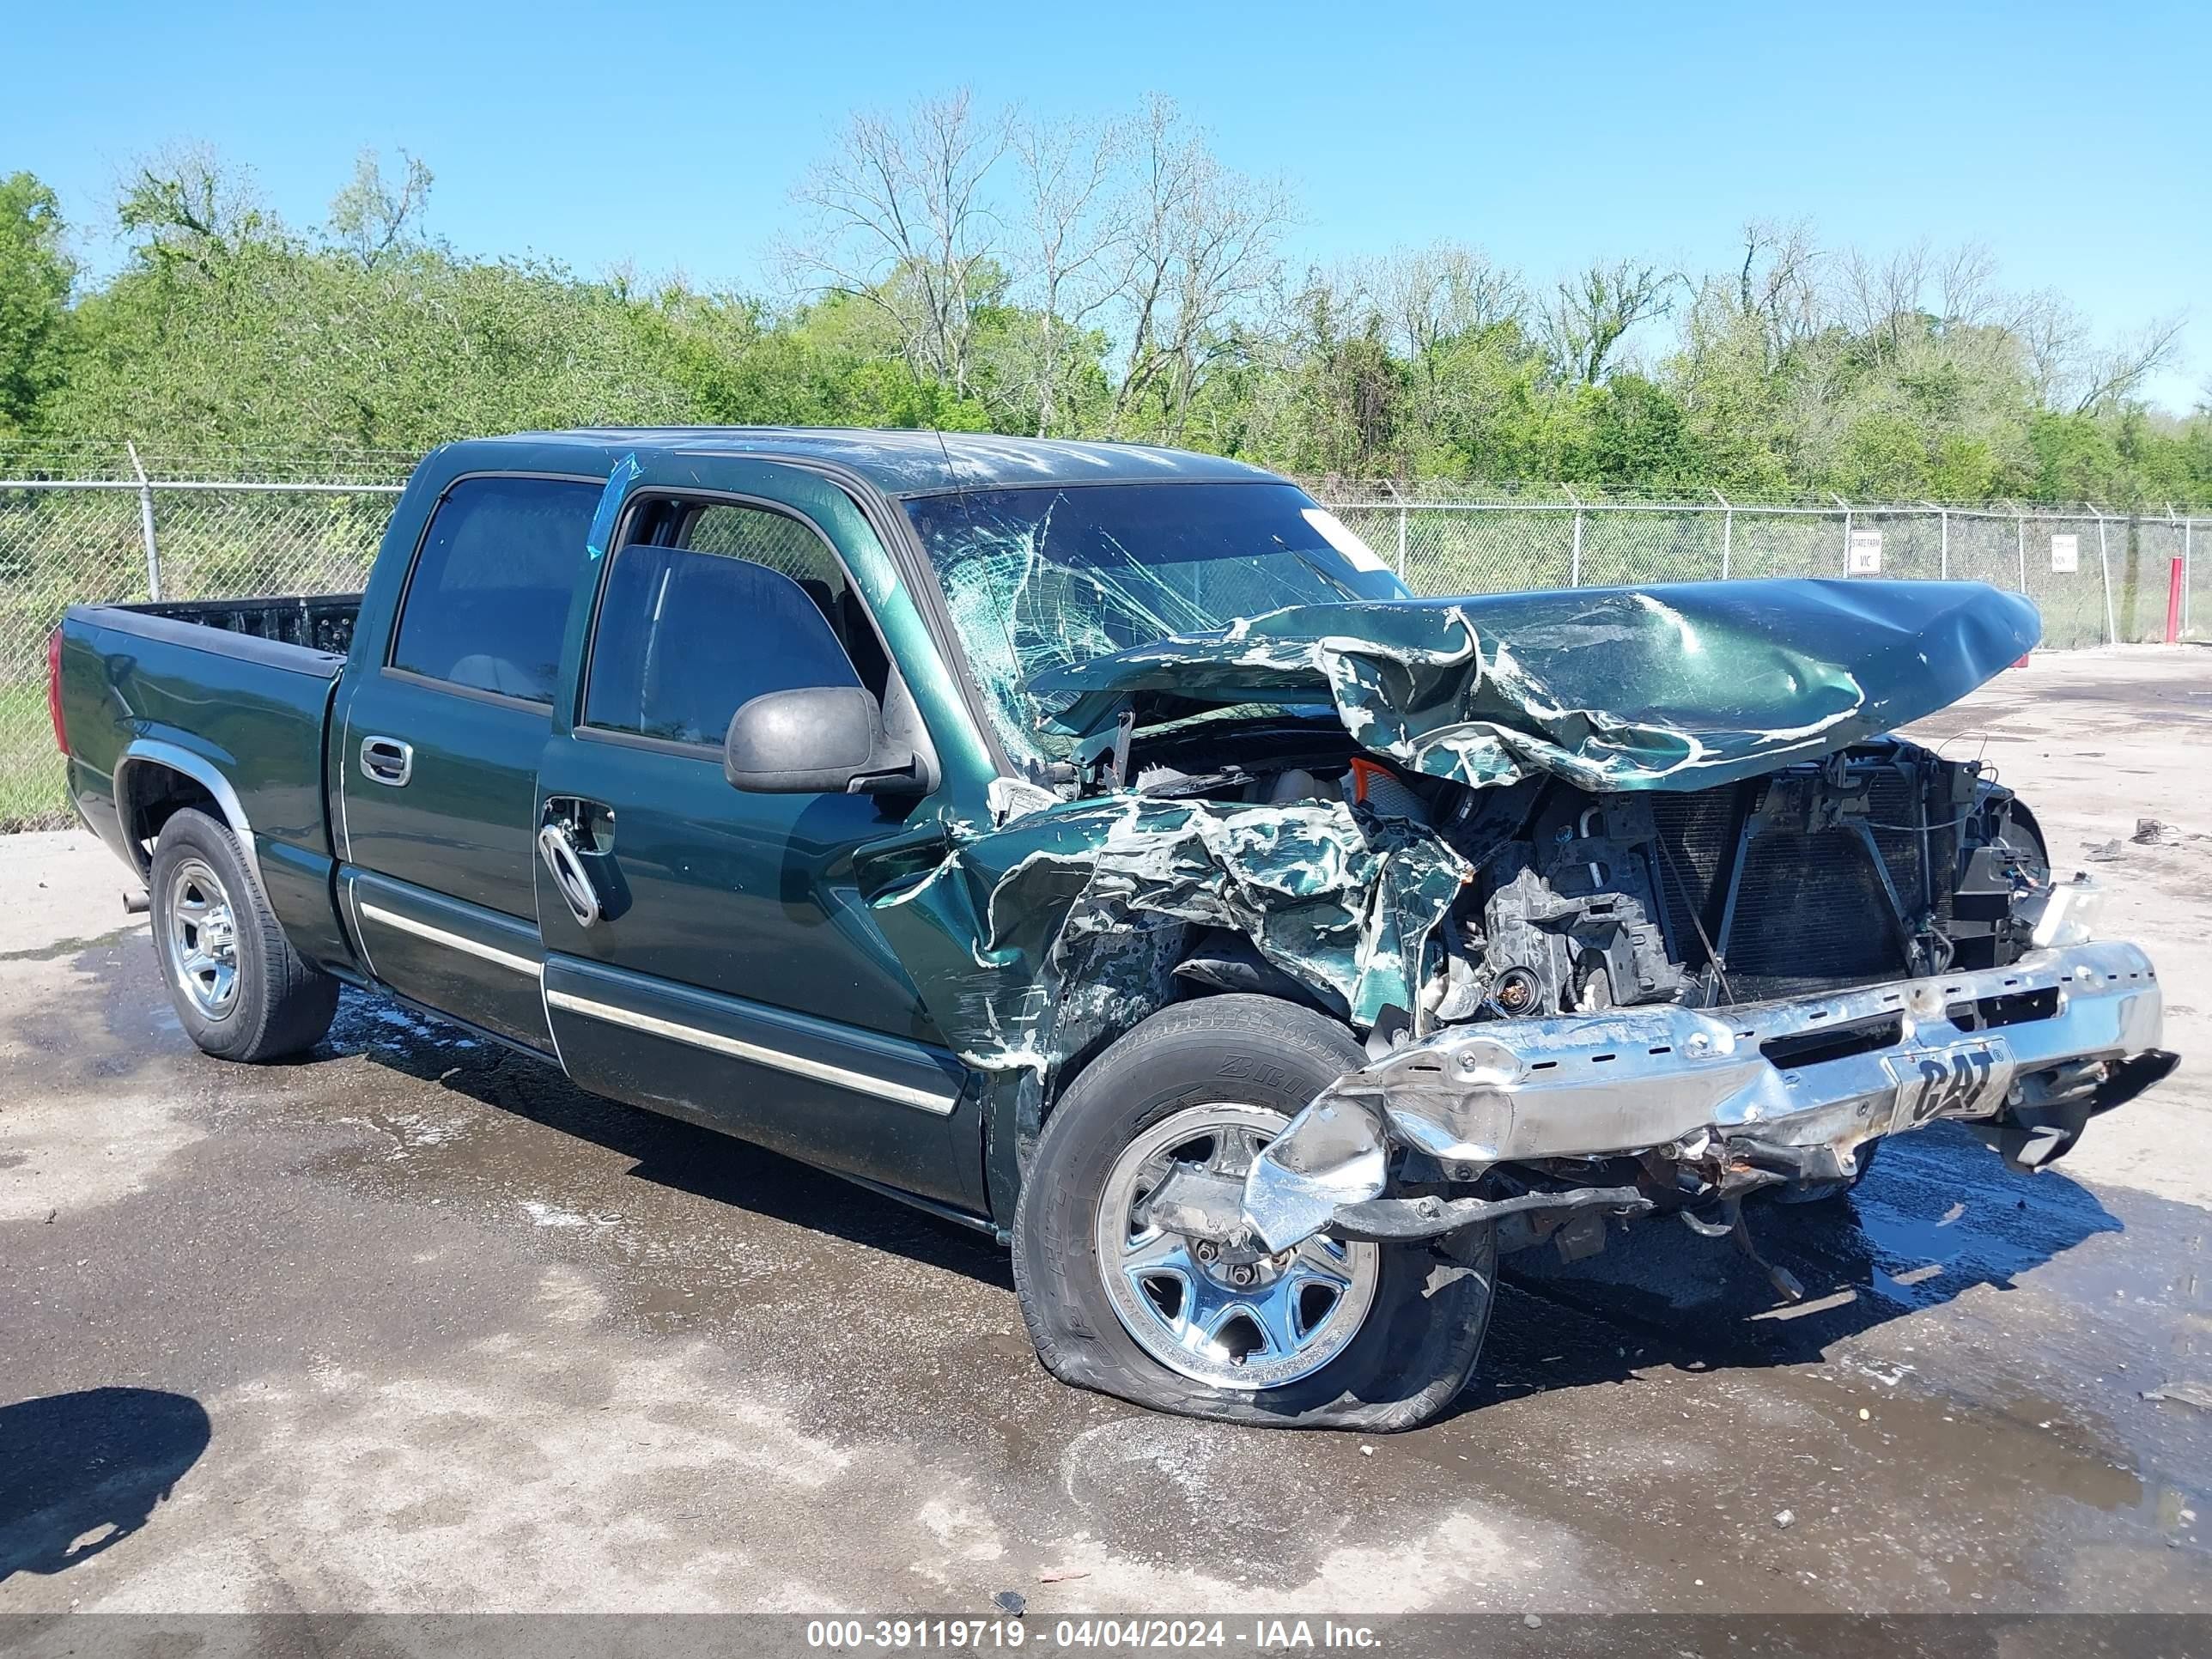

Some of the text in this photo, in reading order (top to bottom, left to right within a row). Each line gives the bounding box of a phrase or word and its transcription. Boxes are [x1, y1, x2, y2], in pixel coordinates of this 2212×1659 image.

[1852, 538, 1866, 548] STATE
[1860, 555, 1871, 567] VIC
[1912, 1051, 1994, 1121] CAT
